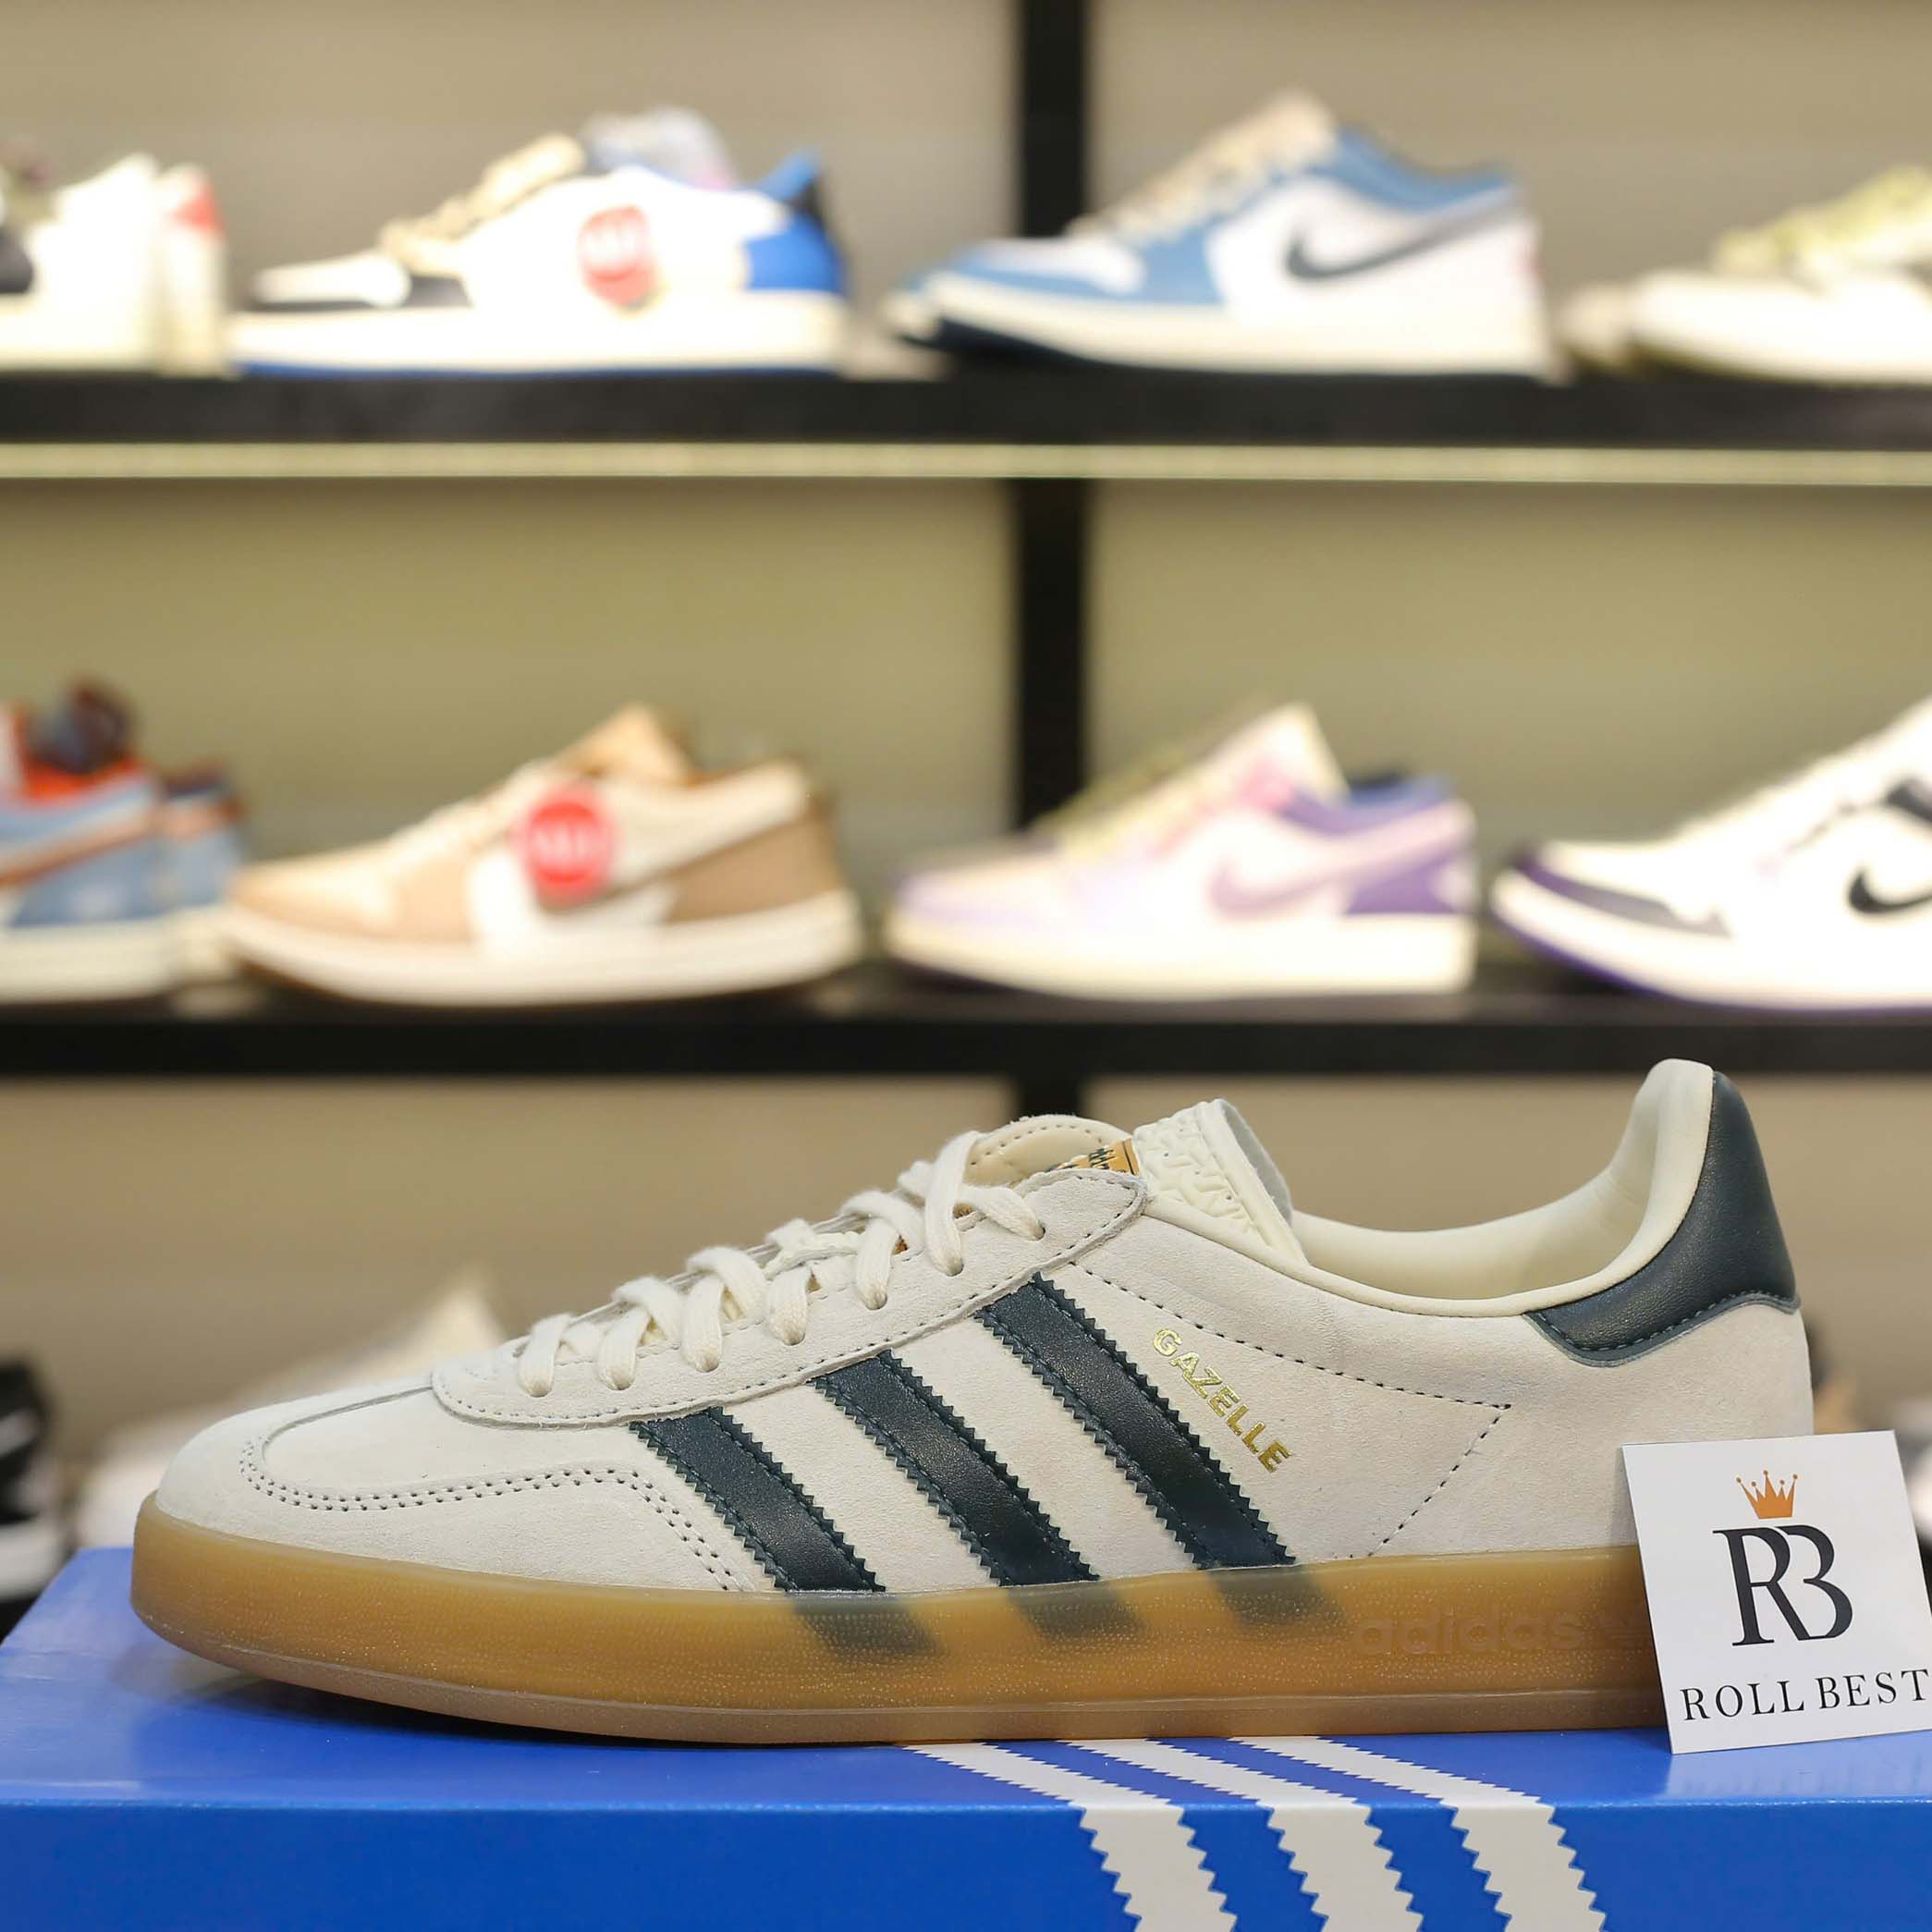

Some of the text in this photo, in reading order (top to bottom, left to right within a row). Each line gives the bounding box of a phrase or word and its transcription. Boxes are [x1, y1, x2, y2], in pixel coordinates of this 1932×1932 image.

[1154, 1328, 1292, 1473] GAZELLE
[1353, 1602, 1583, 1656] adidas
[1712, 1524, 1853, 1646] RB
[1680, 1669, 1929, 1721] ROLL BEST
